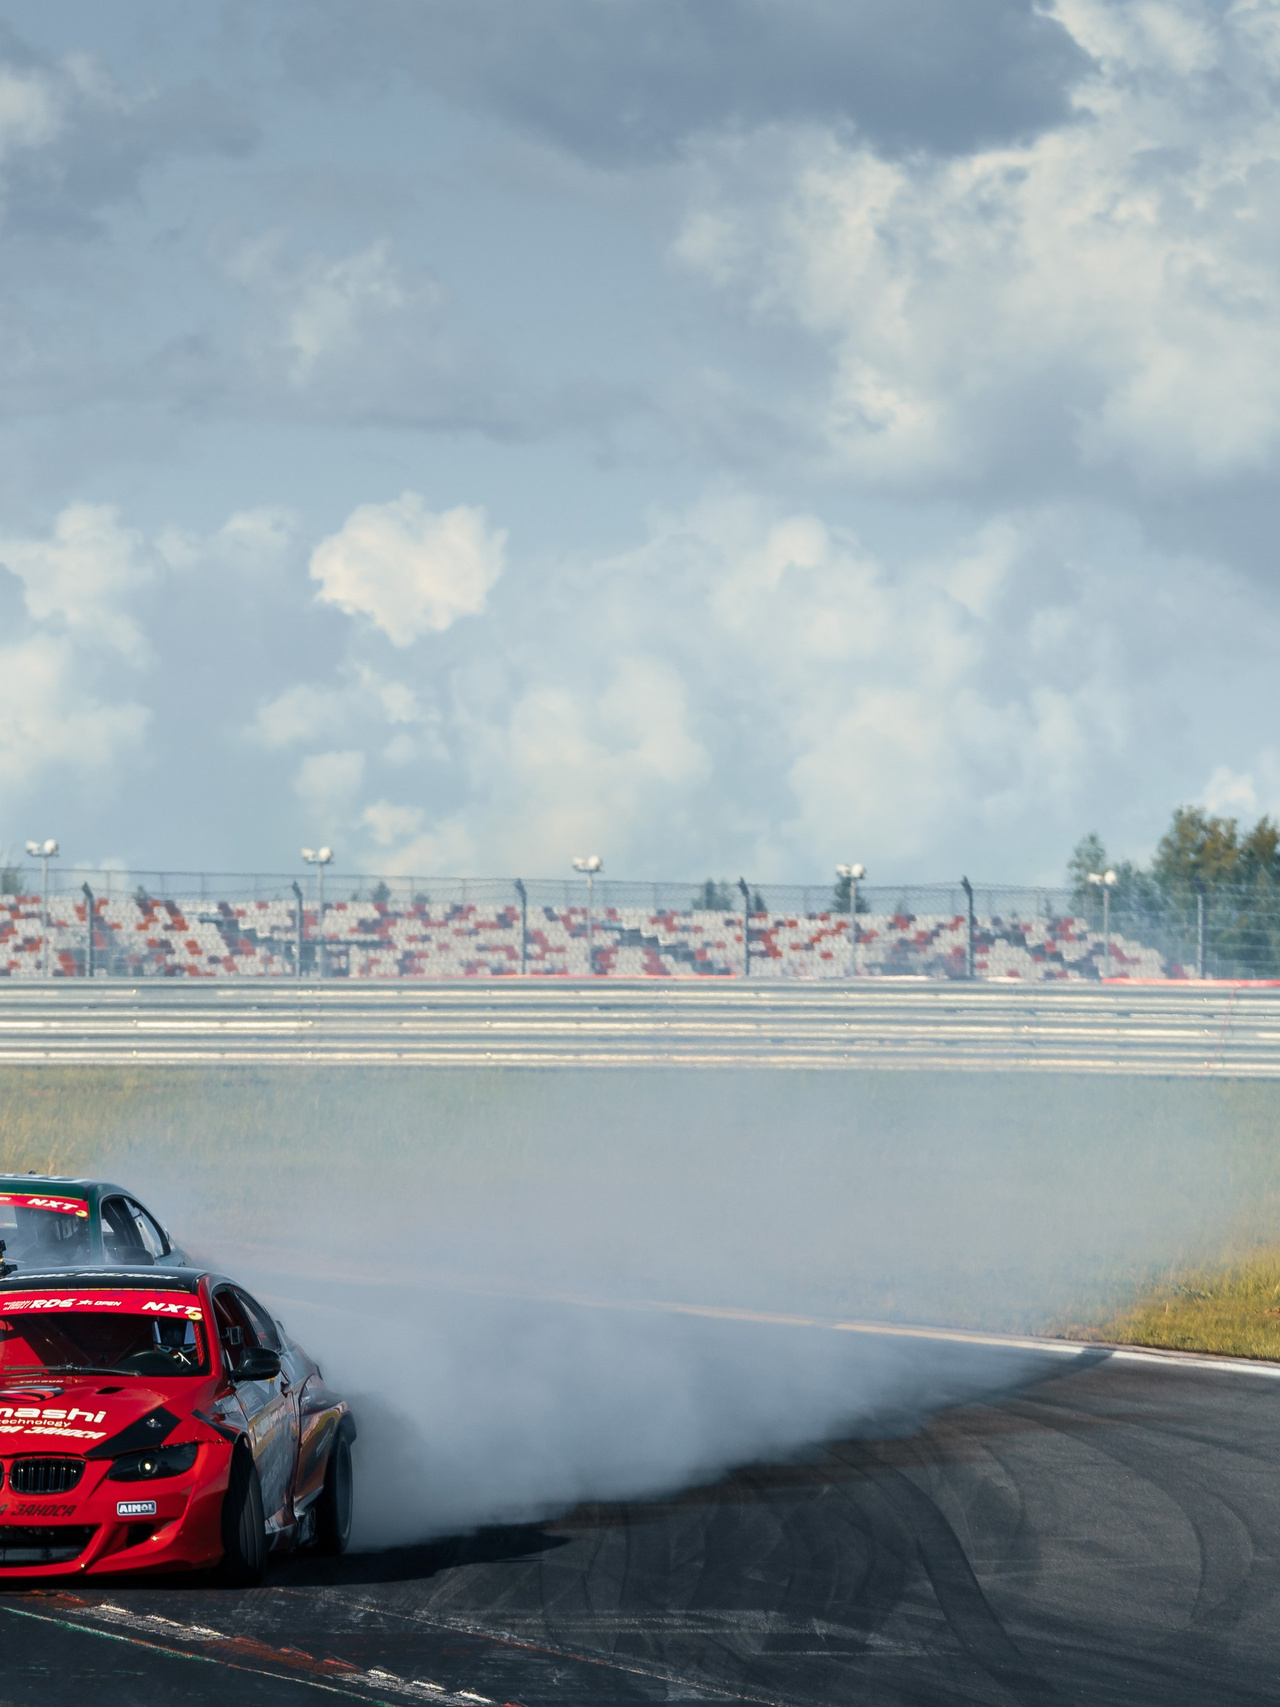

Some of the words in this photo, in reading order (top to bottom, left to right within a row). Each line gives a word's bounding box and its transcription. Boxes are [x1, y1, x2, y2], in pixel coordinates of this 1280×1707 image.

[27, 1198, 79, 1210] NXT
[29, 1298, 77, 1309] RDS
[141, 1301, 202, 1315] NXT
[11, 1503, 77, 1517] ЗАНОСА
[119, 1503, 154, 1513] AIMOL
